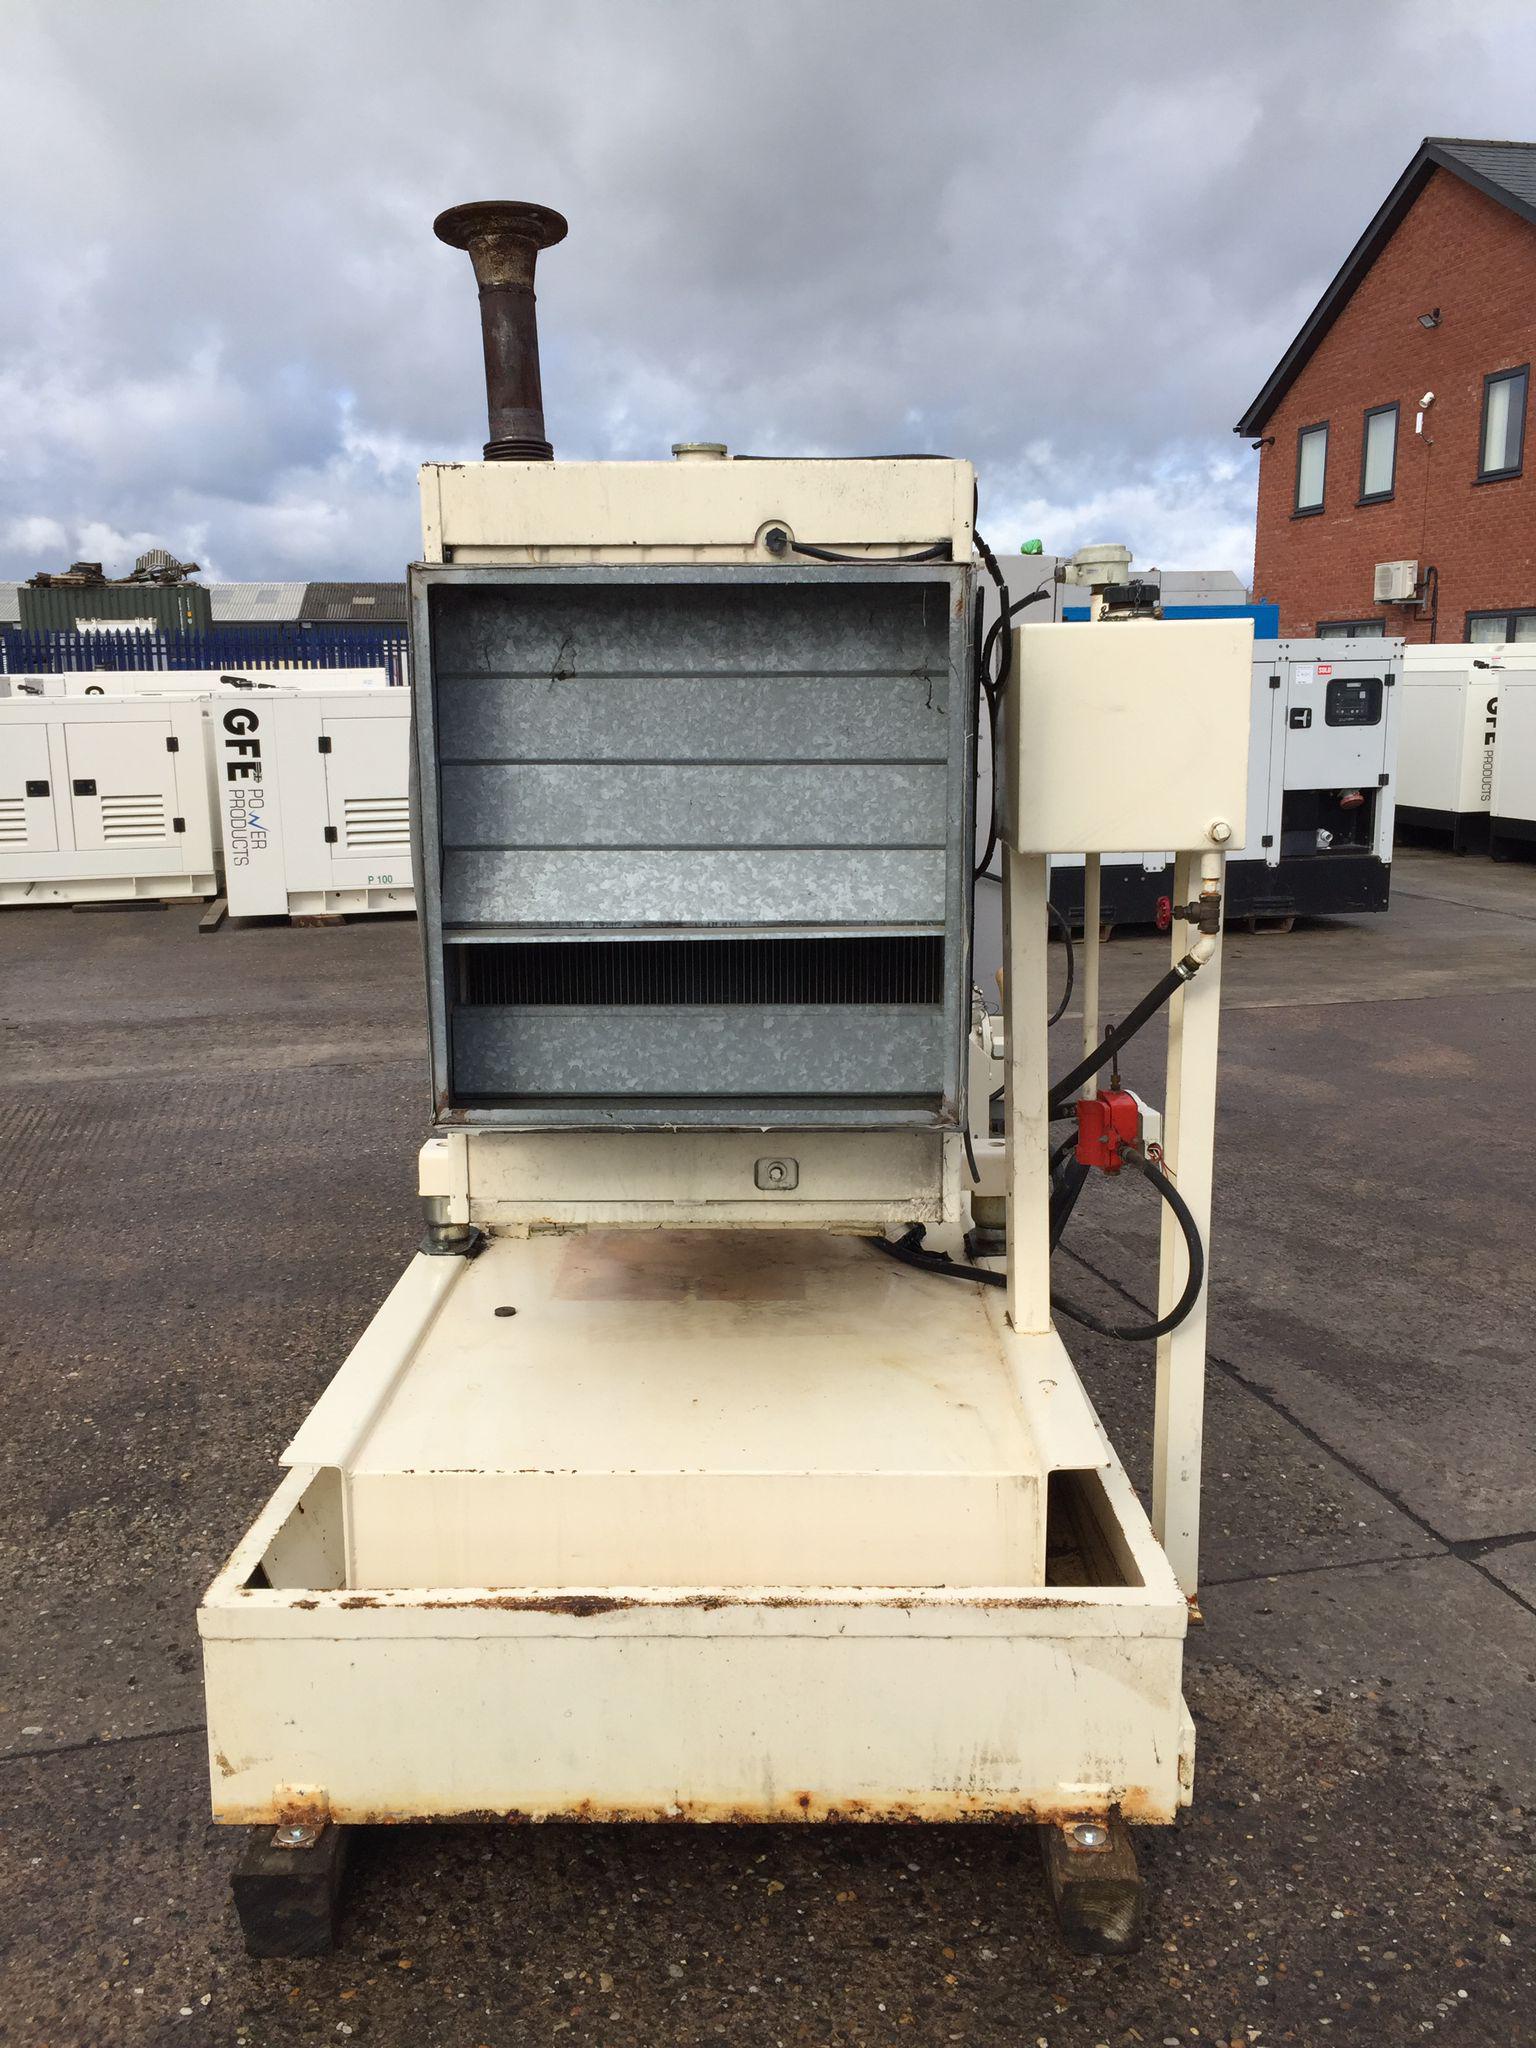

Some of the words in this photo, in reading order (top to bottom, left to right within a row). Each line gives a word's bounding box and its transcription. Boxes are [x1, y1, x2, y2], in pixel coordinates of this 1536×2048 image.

[223, 708, 262, 782] GFE
[1480, 750, 1494, 801] PRODUCTS
[229, 789, 249, 866] PRODUCTS
[247, 789, 271, 849] POWER
[368, 875, 375, 885] P
[377, 875, 393, 884] 100
